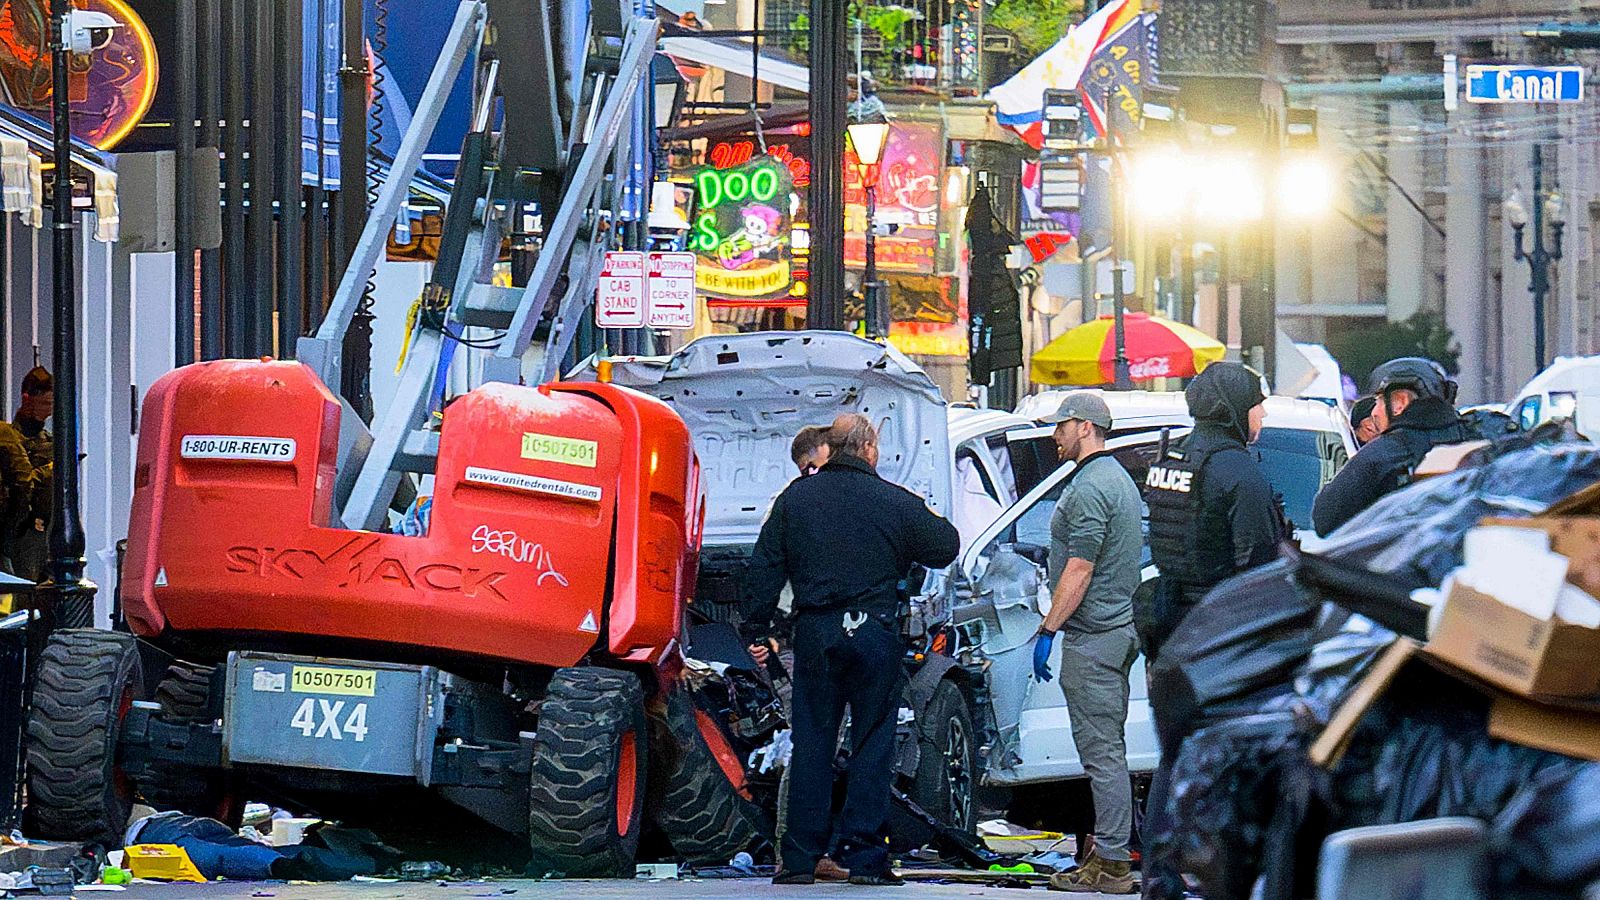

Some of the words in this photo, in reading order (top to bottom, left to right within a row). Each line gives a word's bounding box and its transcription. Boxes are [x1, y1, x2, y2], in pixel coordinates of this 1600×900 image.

[1496, 70, 1562, 100] Canal
[610, 280, 631, 292] CAB
[665, 279, 677, 288] TO
[724, 276, 755, 290] WITH
[604, 296, 637, 309] STAND
[652, 290, 690, 300] CORNER
[651, 312, 690, 323] ANYTIME
[184, 439, 291, 457] 1-800-UR-RENTS
[468, 469, 599, 500] www.unitedrentals.com
[225, 535, 509, 602] SKYJACK
[294, 670, 373, 690] 10507501
[290, 697, 369, 742] 4X4
